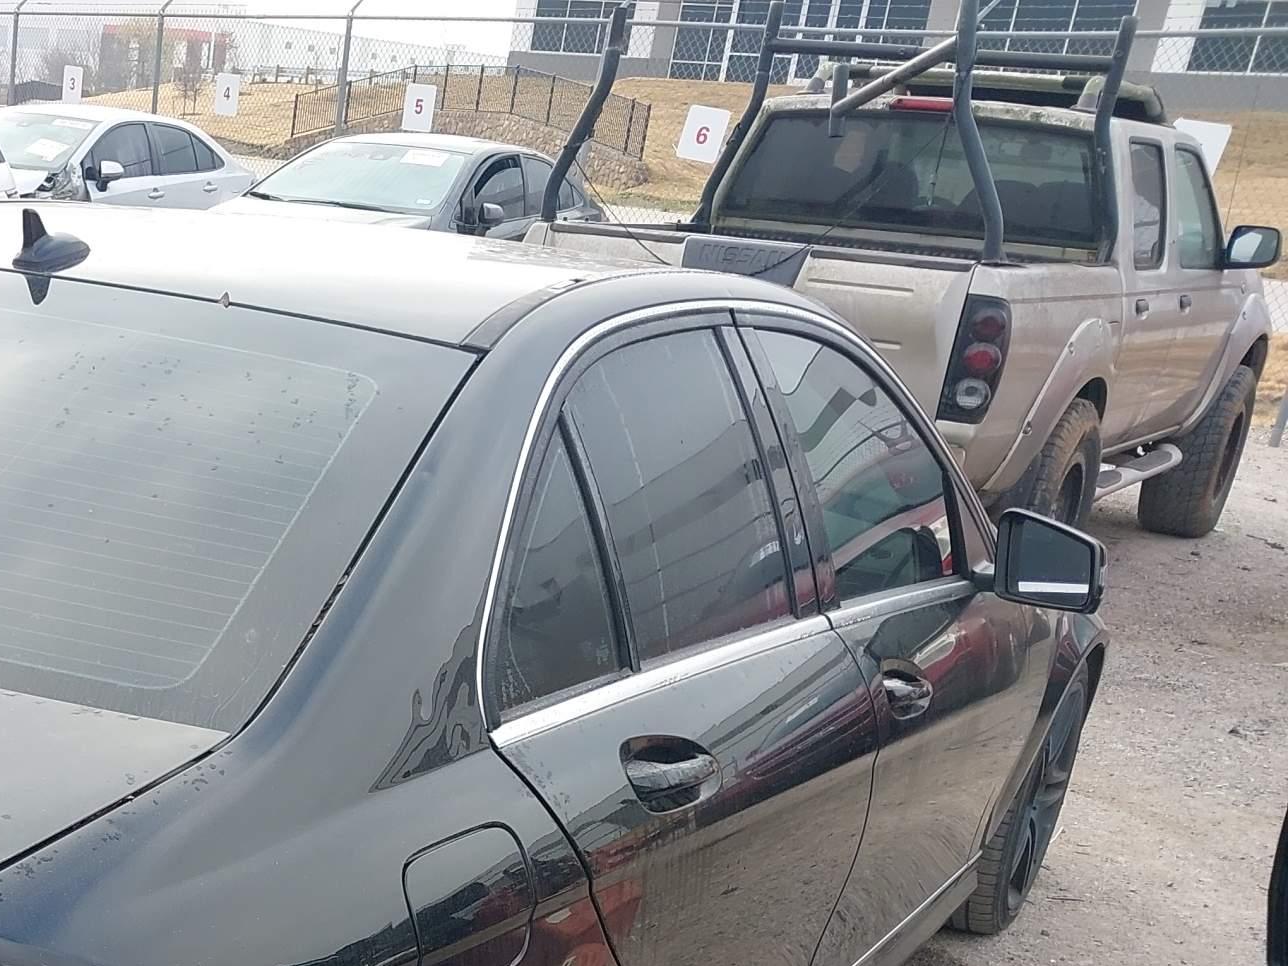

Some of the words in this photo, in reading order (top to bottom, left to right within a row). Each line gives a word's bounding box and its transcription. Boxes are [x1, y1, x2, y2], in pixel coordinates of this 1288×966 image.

[68, 77, 76, 91] 3
[223, 86, 231, 101] 4
[414, 99, 424, 115] 5
[696, 126, 710, 145] 6
[698, 243, 787, 268] NISSAN
